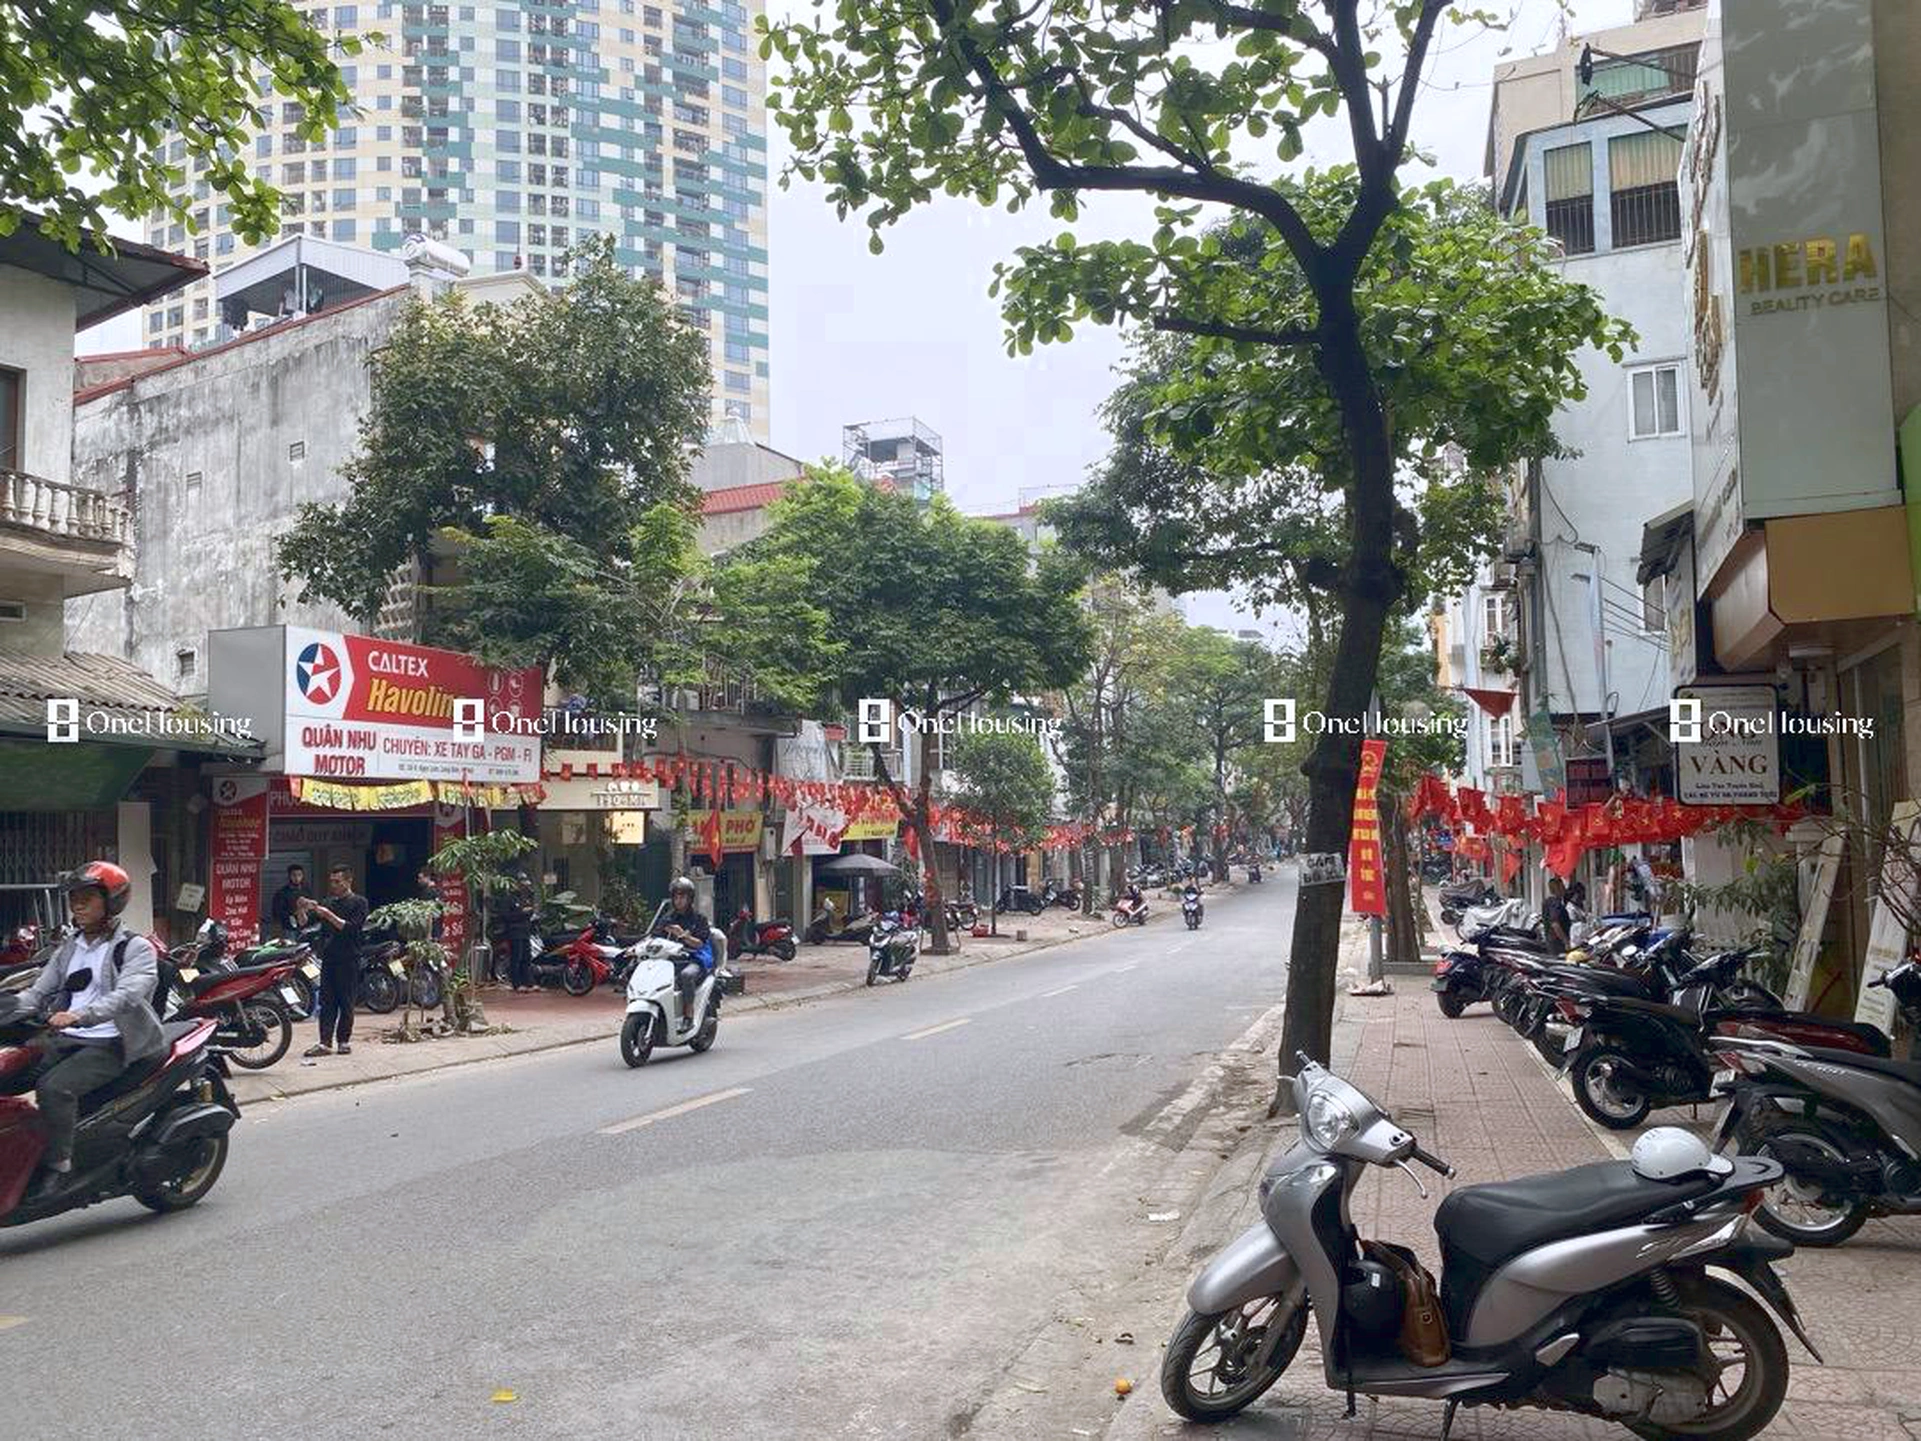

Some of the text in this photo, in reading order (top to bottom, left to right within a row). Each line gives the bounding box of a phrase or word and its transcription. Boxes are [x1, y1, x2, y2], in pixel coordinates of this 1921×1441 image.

[1738, 232, 1878, 293] HERA
[1828, 287, 1880, 306] CARE
[367, 650, 429, 678] CALTEX
[302, 723, 376, 751] QUÂN NHU
[435, 741, 448, 757] XE
[451, 743, 468, 758] TAY
[472, 745, 486, 760] GA
[1691, 749, 1768, 775] VÀNG
[314, 754, 366, 776] MOTOR
